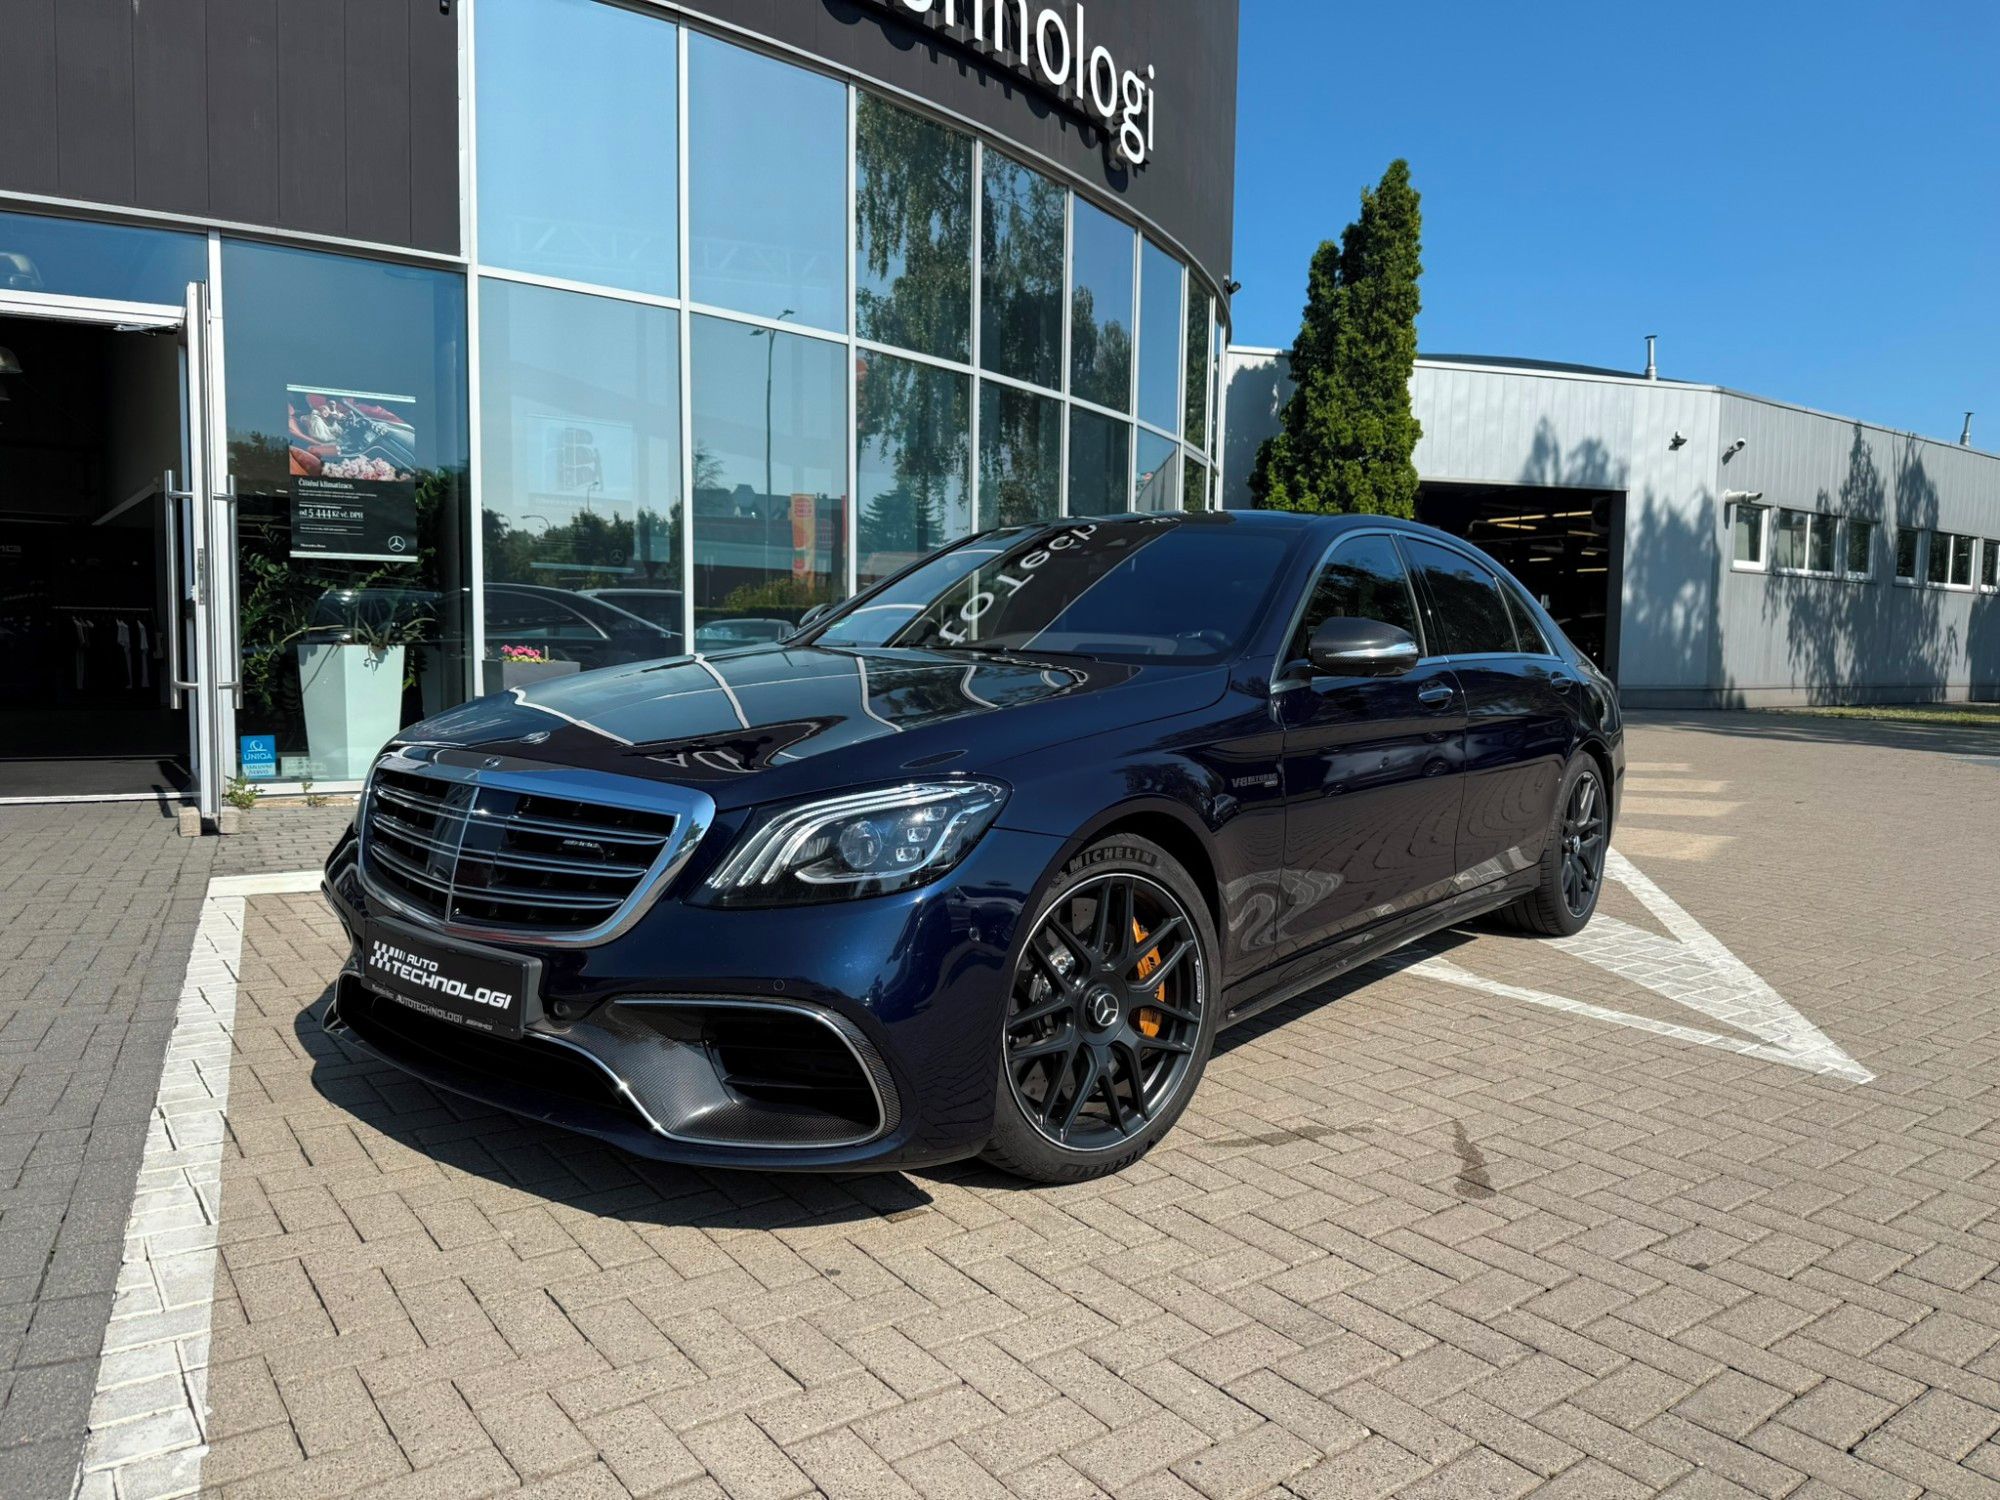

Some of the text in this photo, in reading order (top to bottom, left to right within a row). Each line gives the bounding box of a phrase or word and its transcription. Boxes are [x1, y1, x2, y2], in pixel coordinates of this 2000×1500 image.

[904, 0, 1154, 164] nologi
[244, 753, 273, 761] UNIQA
[1231, 776, 1247, 788] V8
[1068, 846, 1155, 874] MICHELIN
[407, 953, 439, 972] AUTO
[392, 960, 513, 1010] TECHNOLOGI
